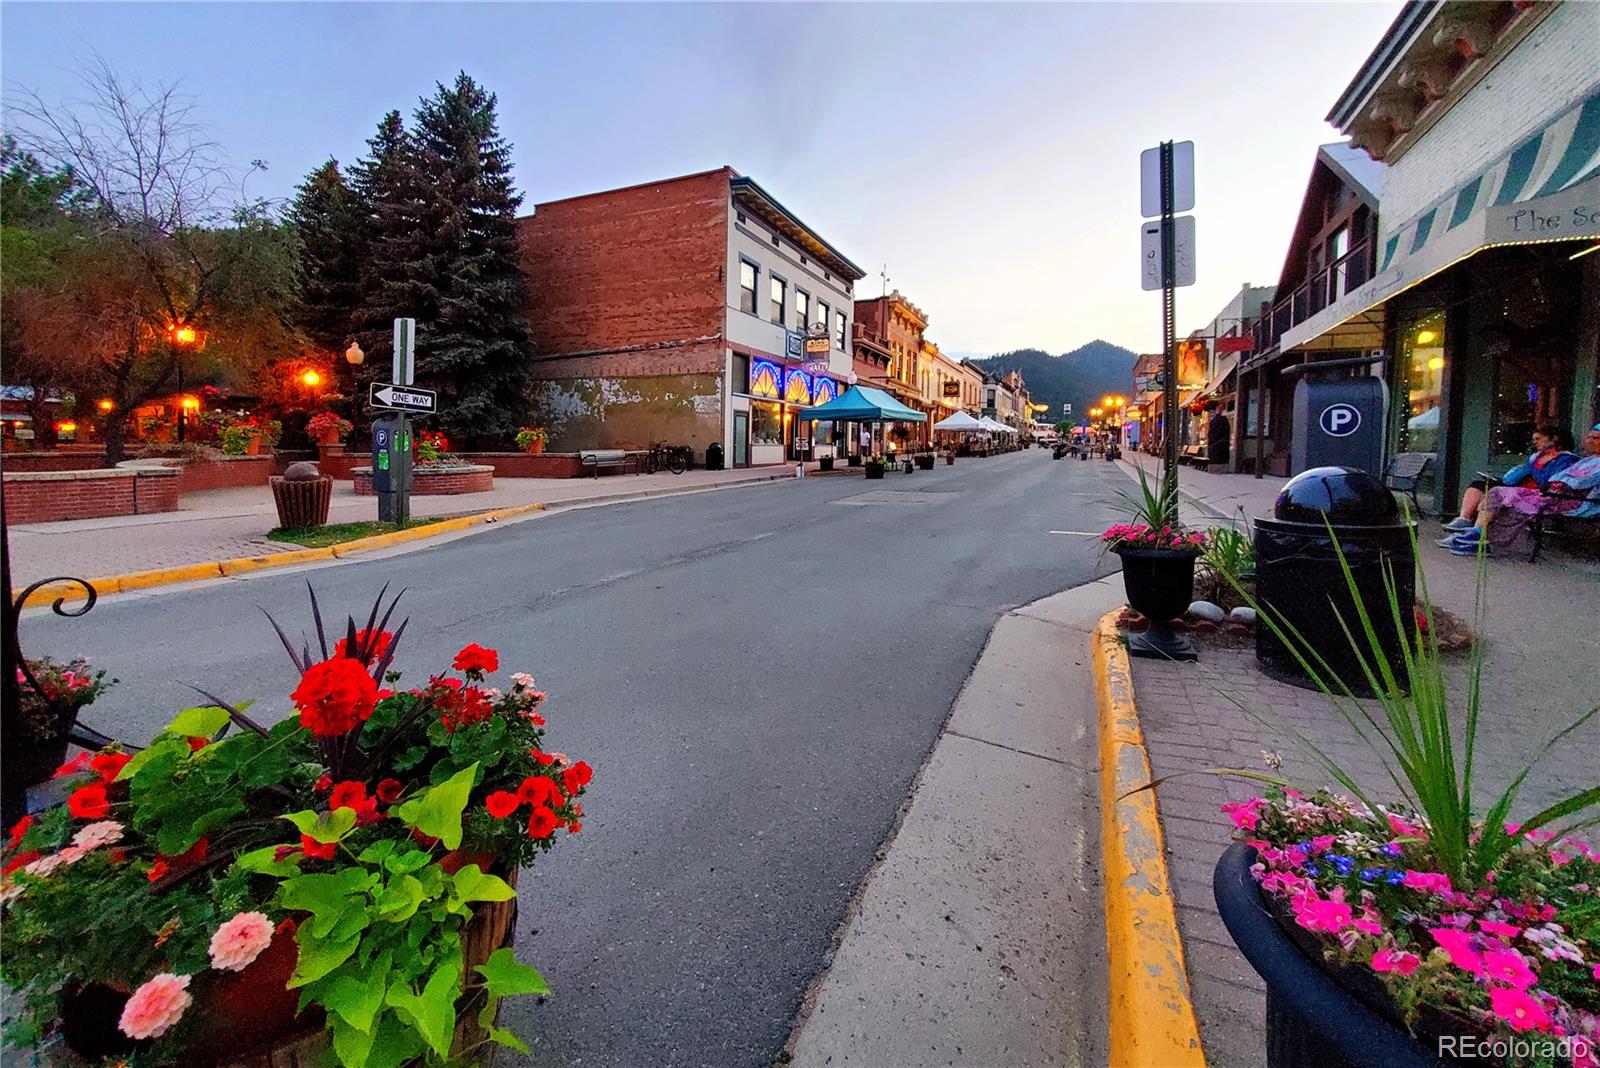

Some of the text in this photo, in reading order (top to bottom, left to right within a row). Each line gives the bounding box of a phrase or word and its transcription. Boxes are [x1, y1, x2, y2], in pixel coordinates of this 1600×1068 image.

[1506, 208, 1560, 232] The
[391, 393, 430, 405] ONE WAY
[1331, 409, 1352, 431] P
